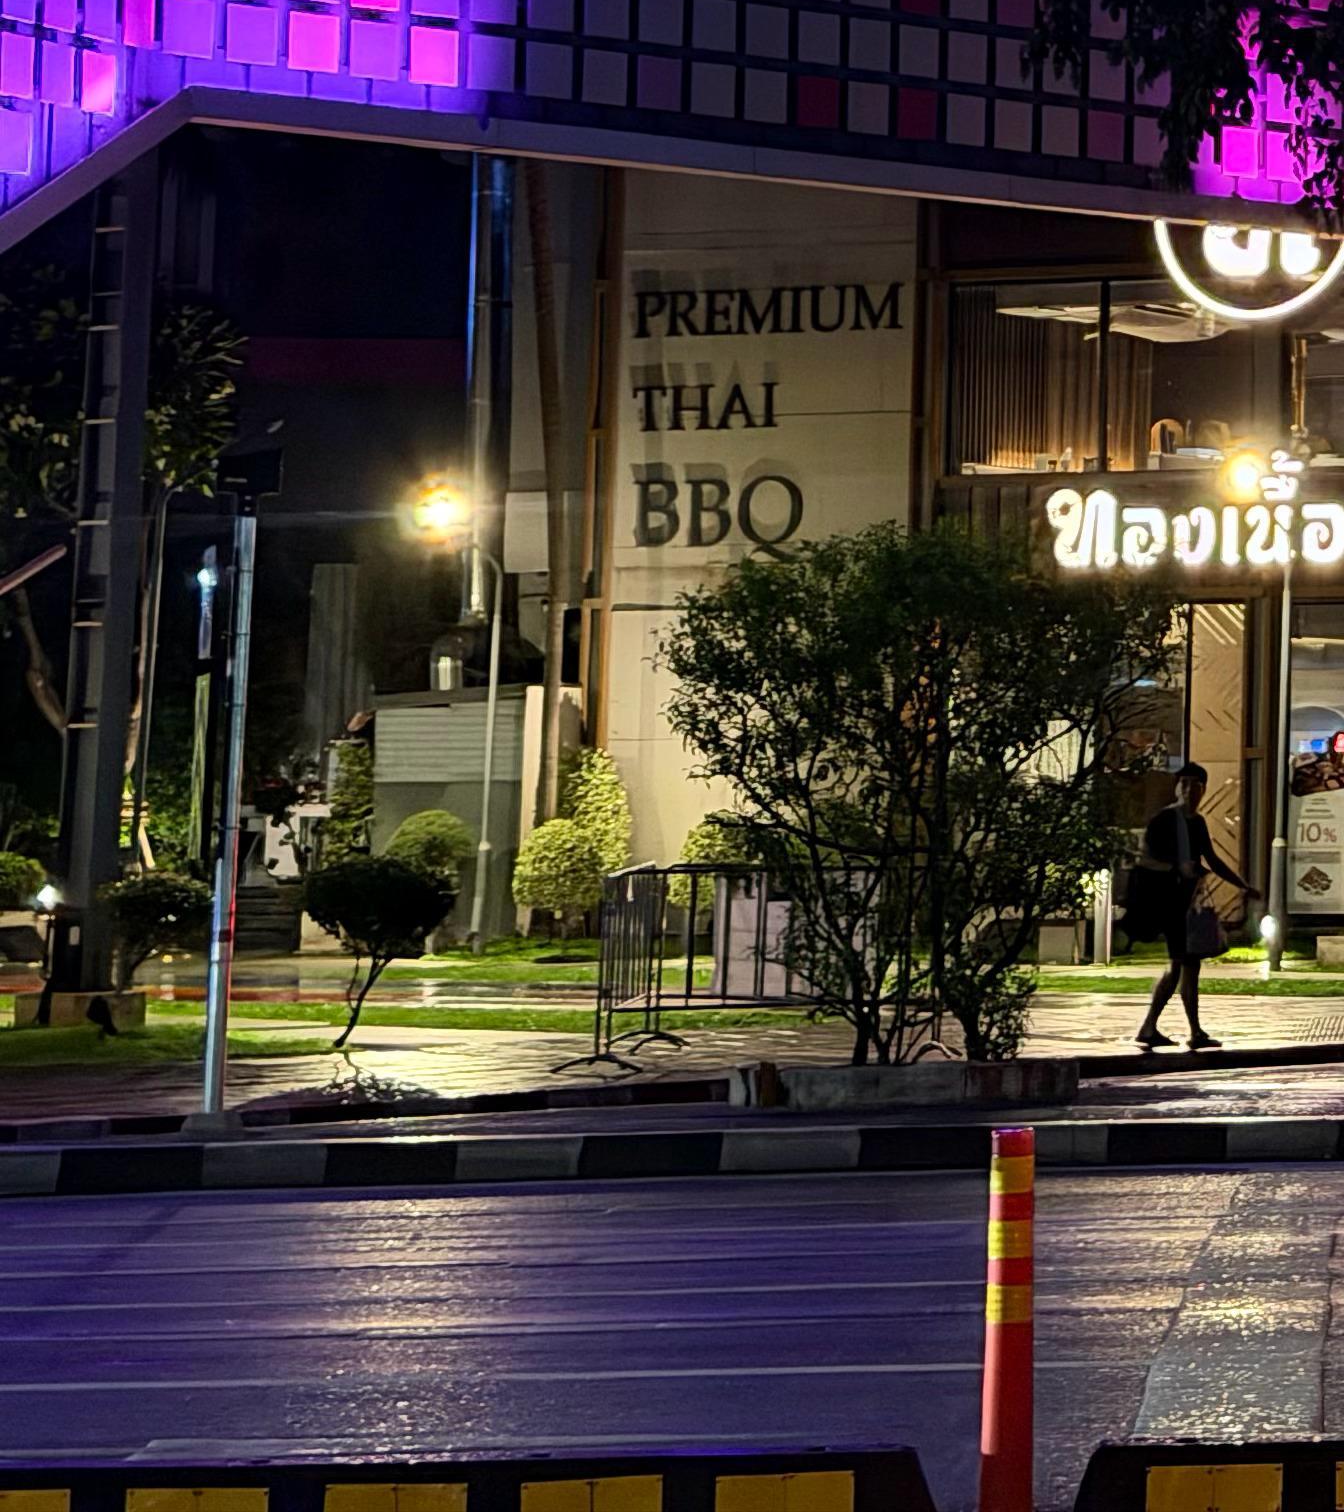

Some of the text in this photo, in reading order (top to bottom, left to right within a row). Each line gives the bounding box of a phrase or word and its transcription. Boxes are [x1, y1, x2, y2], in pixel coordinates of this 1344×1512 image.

[633, 282, 905, 339] PREMIUM
[632, 381, 780, 433] THAI
[632, 474, 804, 563] BBQ
[1300, 822, 1338, 843] 10%
